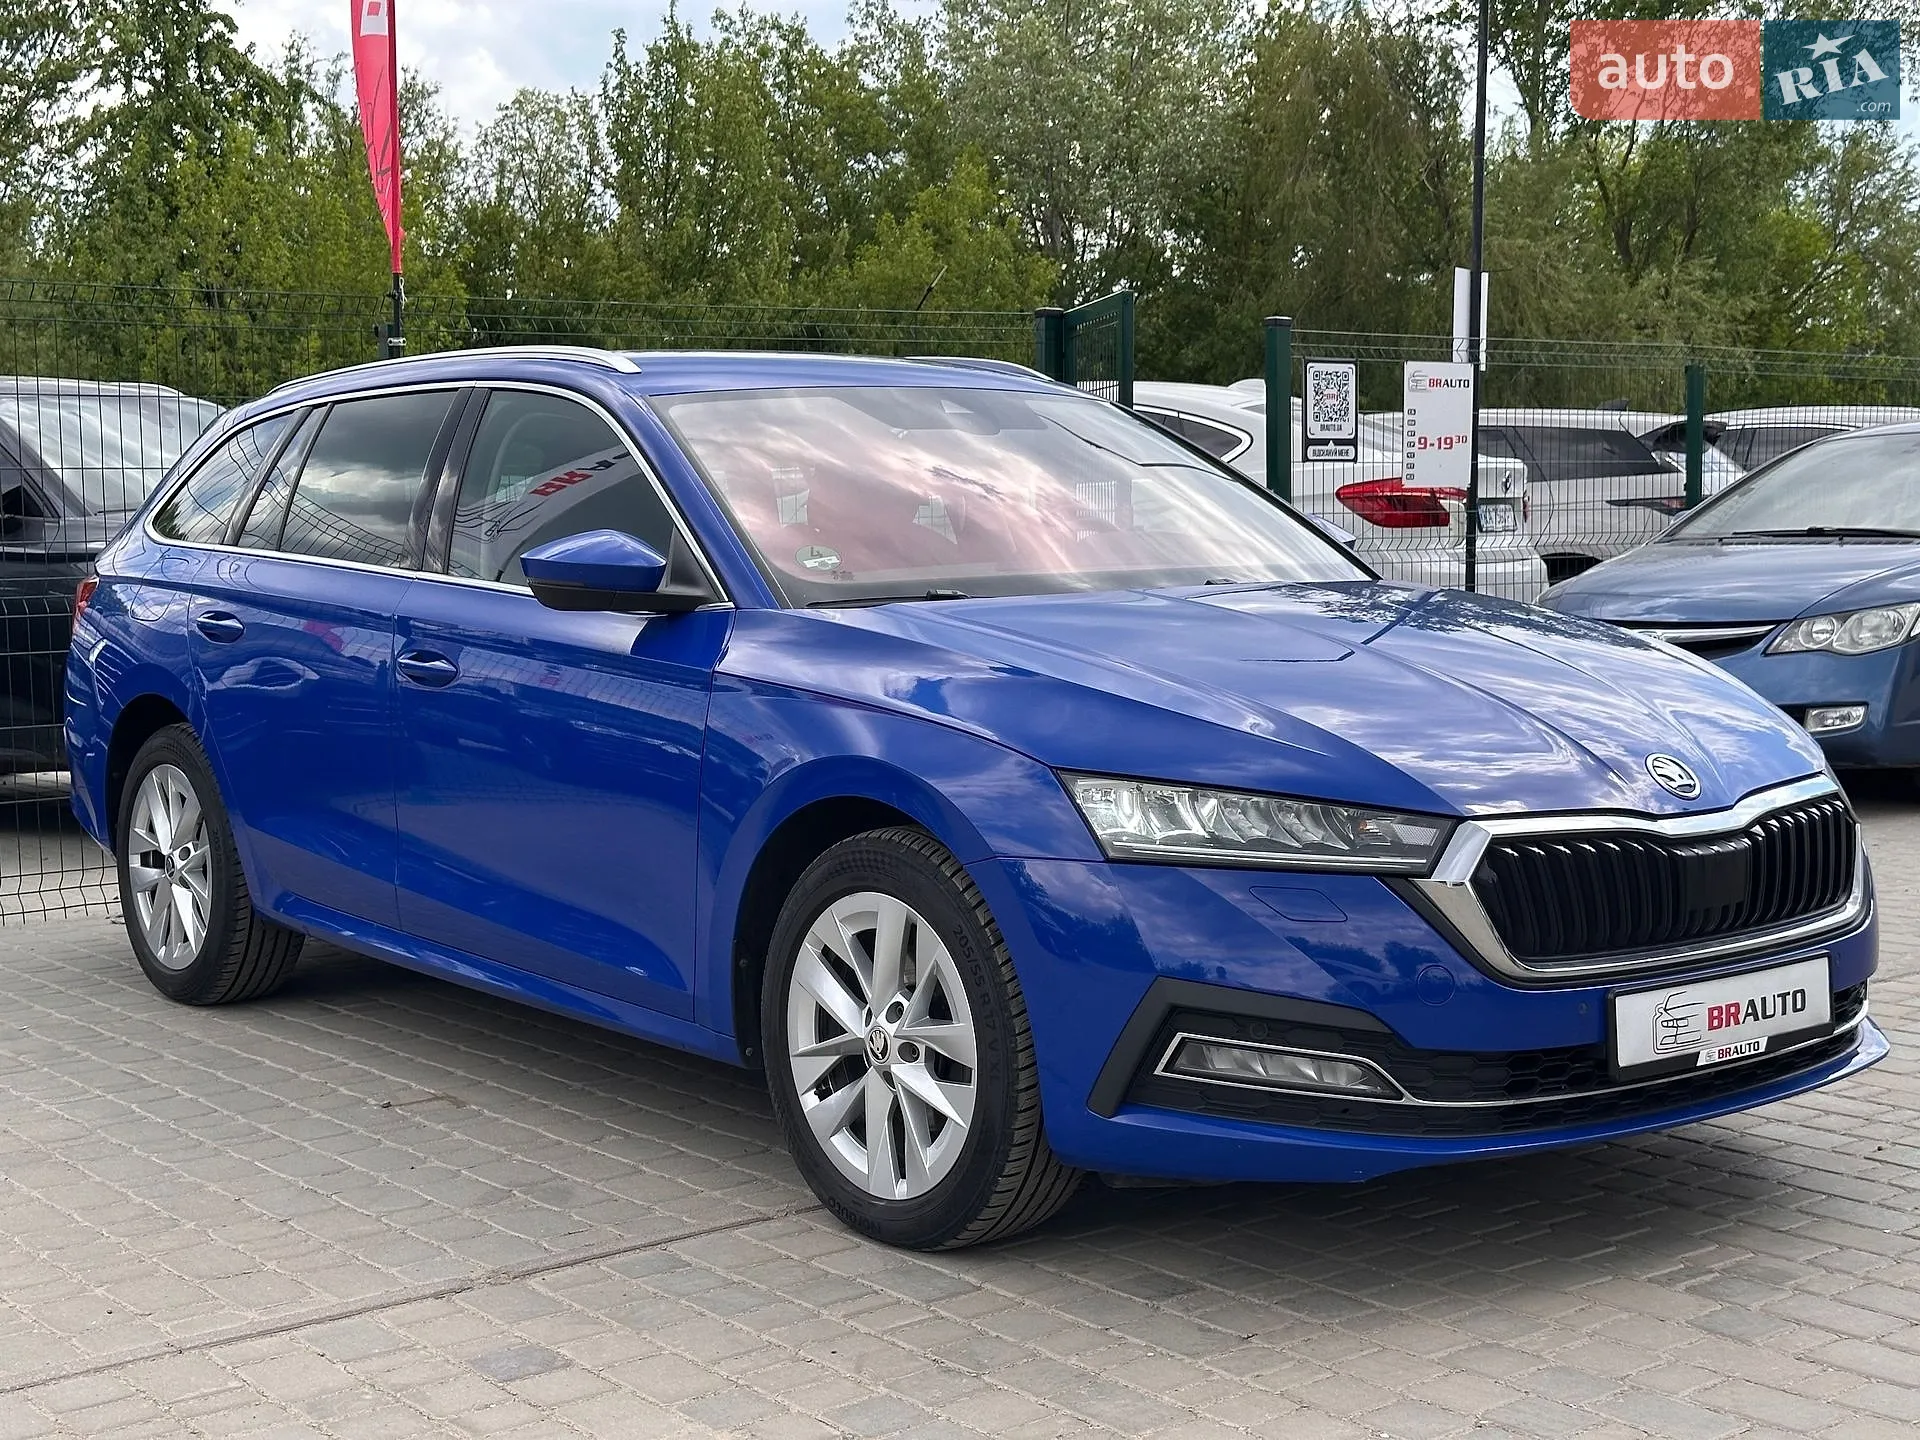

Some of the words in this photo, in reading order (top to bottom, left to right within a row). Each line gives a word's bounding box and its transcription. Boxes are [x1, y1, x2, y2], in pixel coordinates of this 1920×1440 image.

[1428, 377, 1470, 389] BRAUTO
[1707, 988, 1806, 1032] BRAUTO
[1717, 1041, 1760, 1060] BRAUTO
